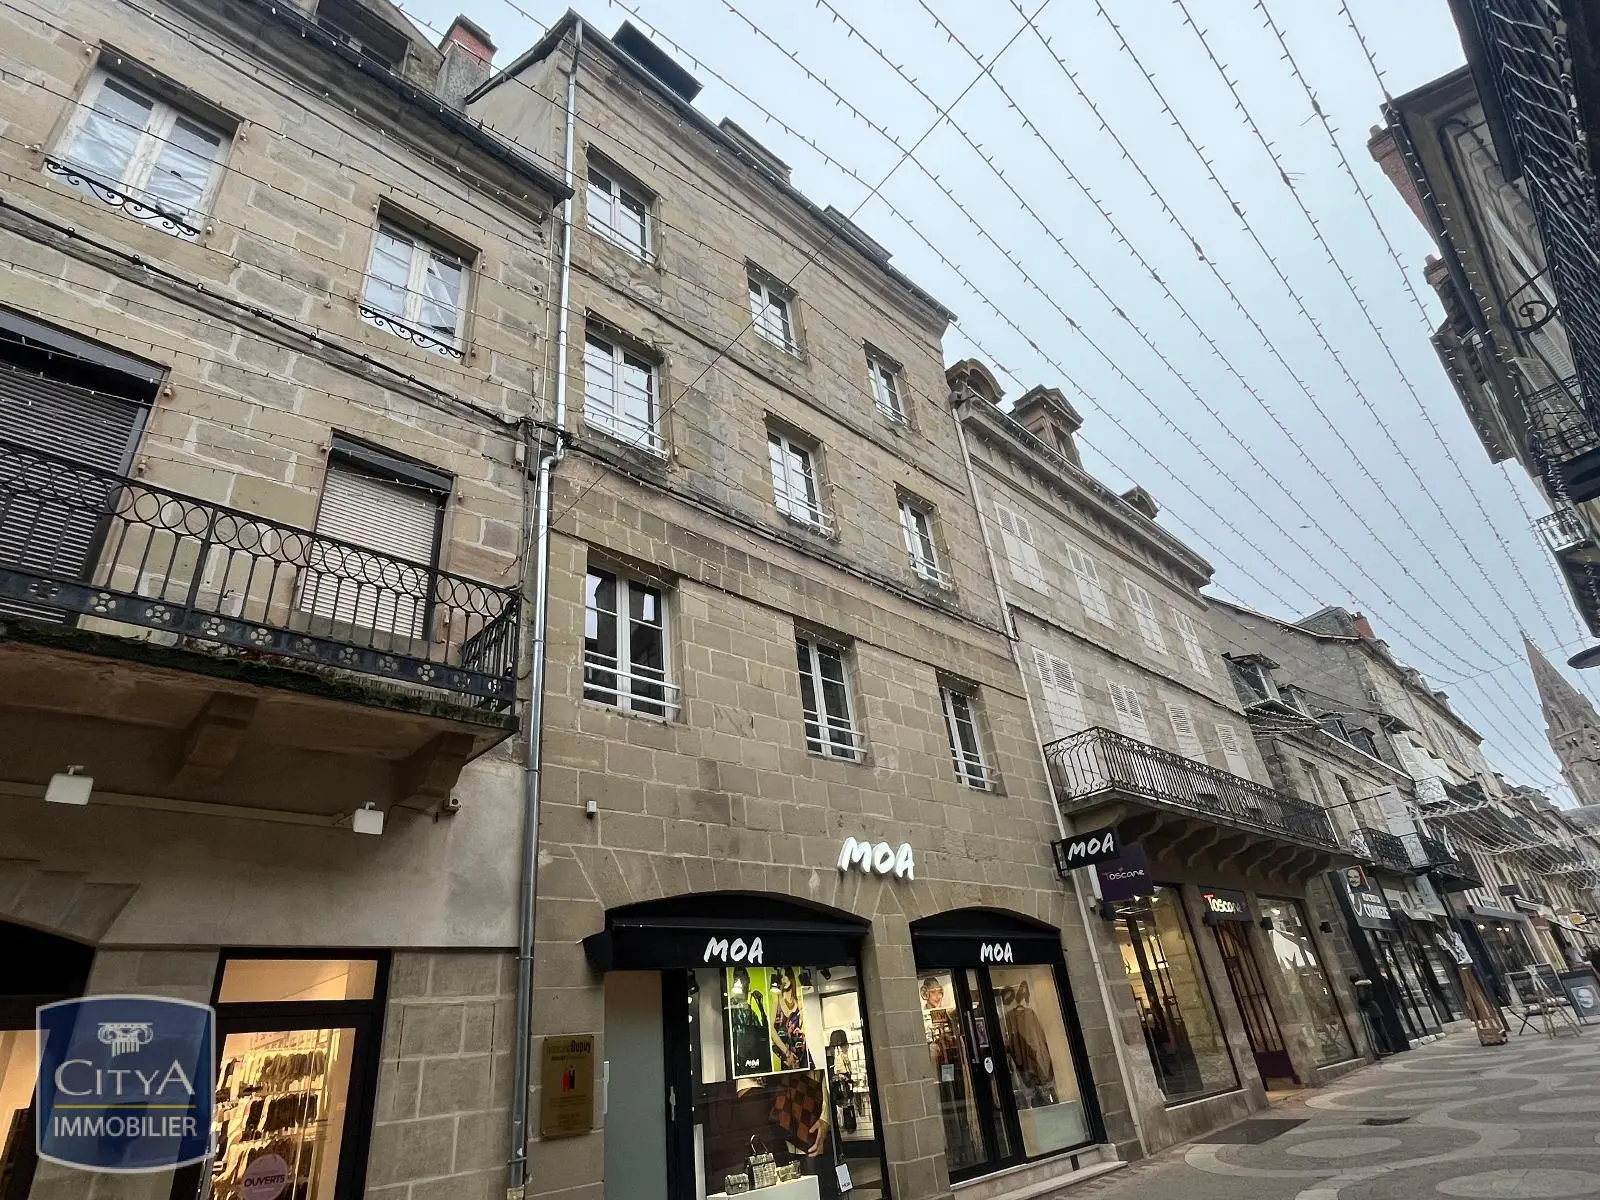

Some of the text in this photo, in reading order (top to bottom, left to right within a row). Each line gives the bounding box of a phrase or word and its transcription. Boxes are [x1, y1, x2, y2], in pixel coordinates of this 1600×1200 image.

[836, 837, 916, 880] MOA
[1067, 833, 1115, 862] MOA
[1101, 869, 1145, 881] Toscane
[703, 936, 764, 964] MOA
[979, 942, 1014, 964] MOA
[244, 1174, 286, 1187] OUVERTS
